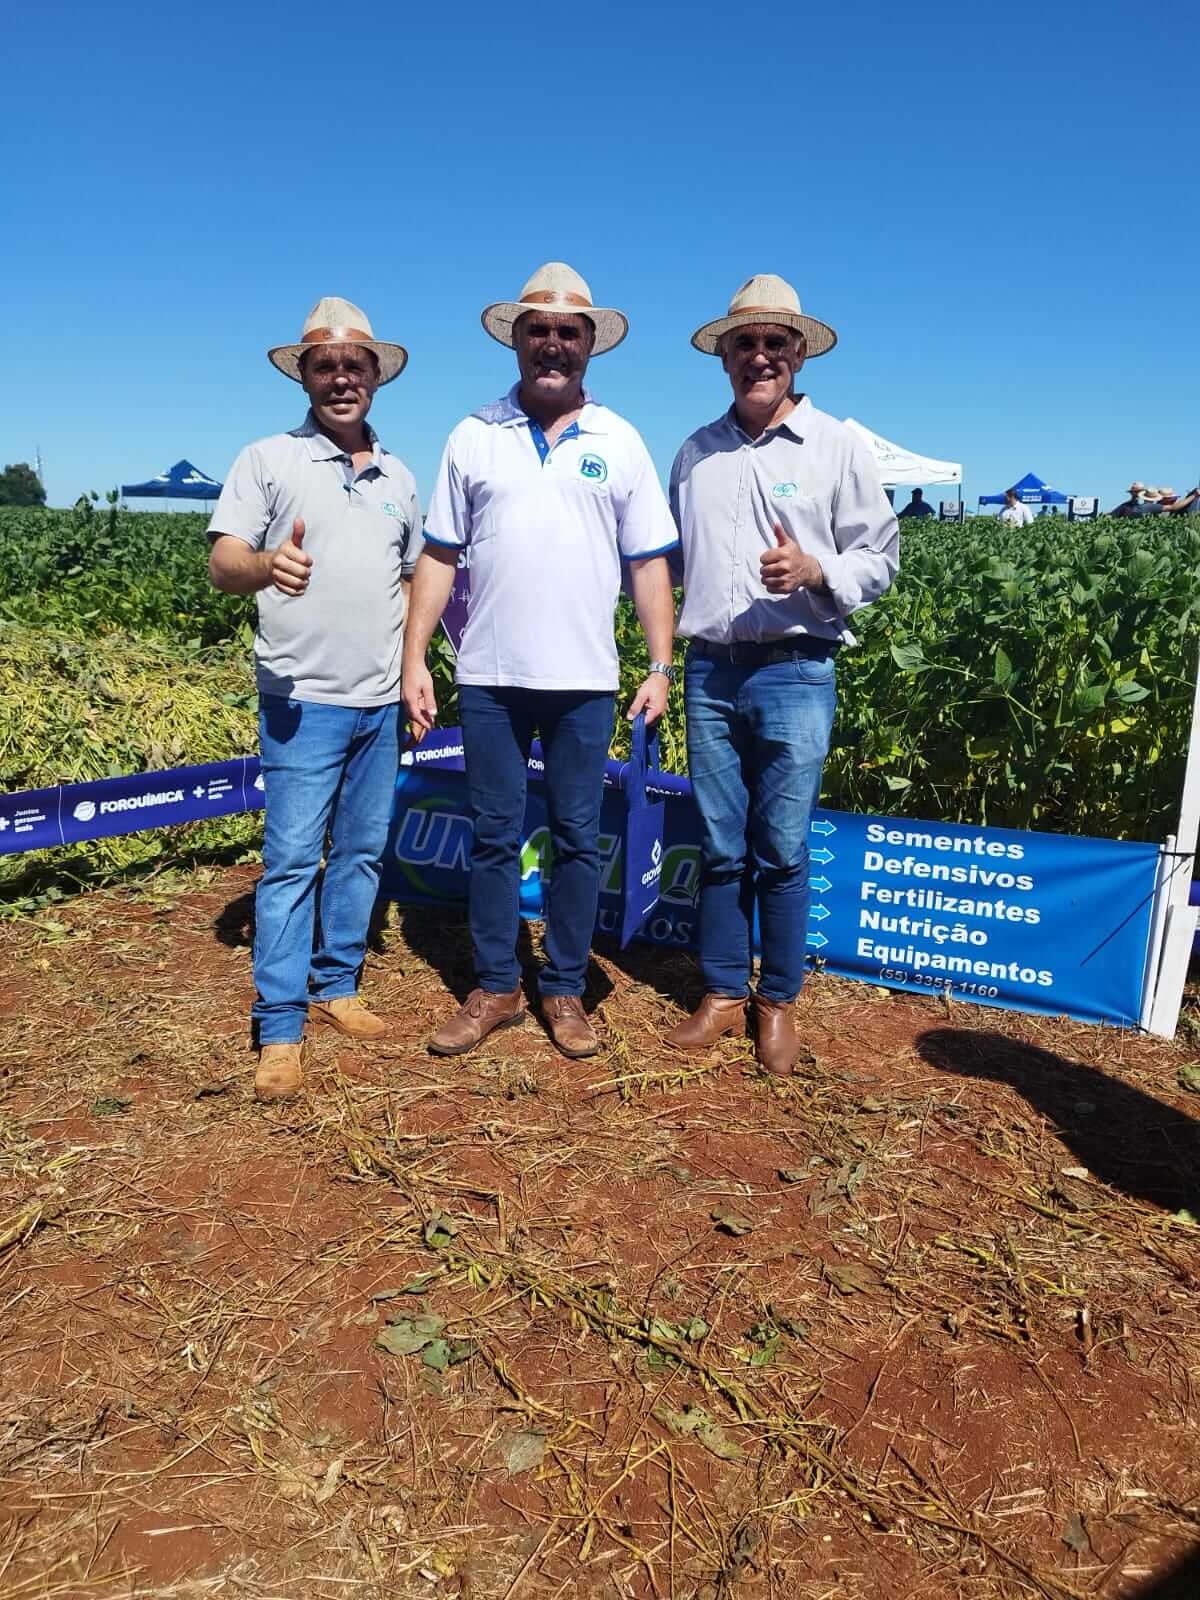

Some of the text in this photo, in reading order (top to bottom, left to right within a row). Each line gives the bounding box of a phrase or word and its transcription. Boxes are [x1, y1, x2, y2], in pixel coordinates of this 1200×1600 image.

[581, 458, 602, 477] HS
[415, 745, 464, 762] FORQUÍMIC
[100, 790, 184, 815] FORQUÍMICA
[866, 824, 1025, 860] Sementes
[863, 851, 1034, 890] Defensivos
[860, 881, 1041, 924] Fertilizantes
[859, 909, 988, 946] Nutrição
[857, 938, 1054, 986] Equipamentos
[879, 967, 999, 999] (55) 3355-1160
